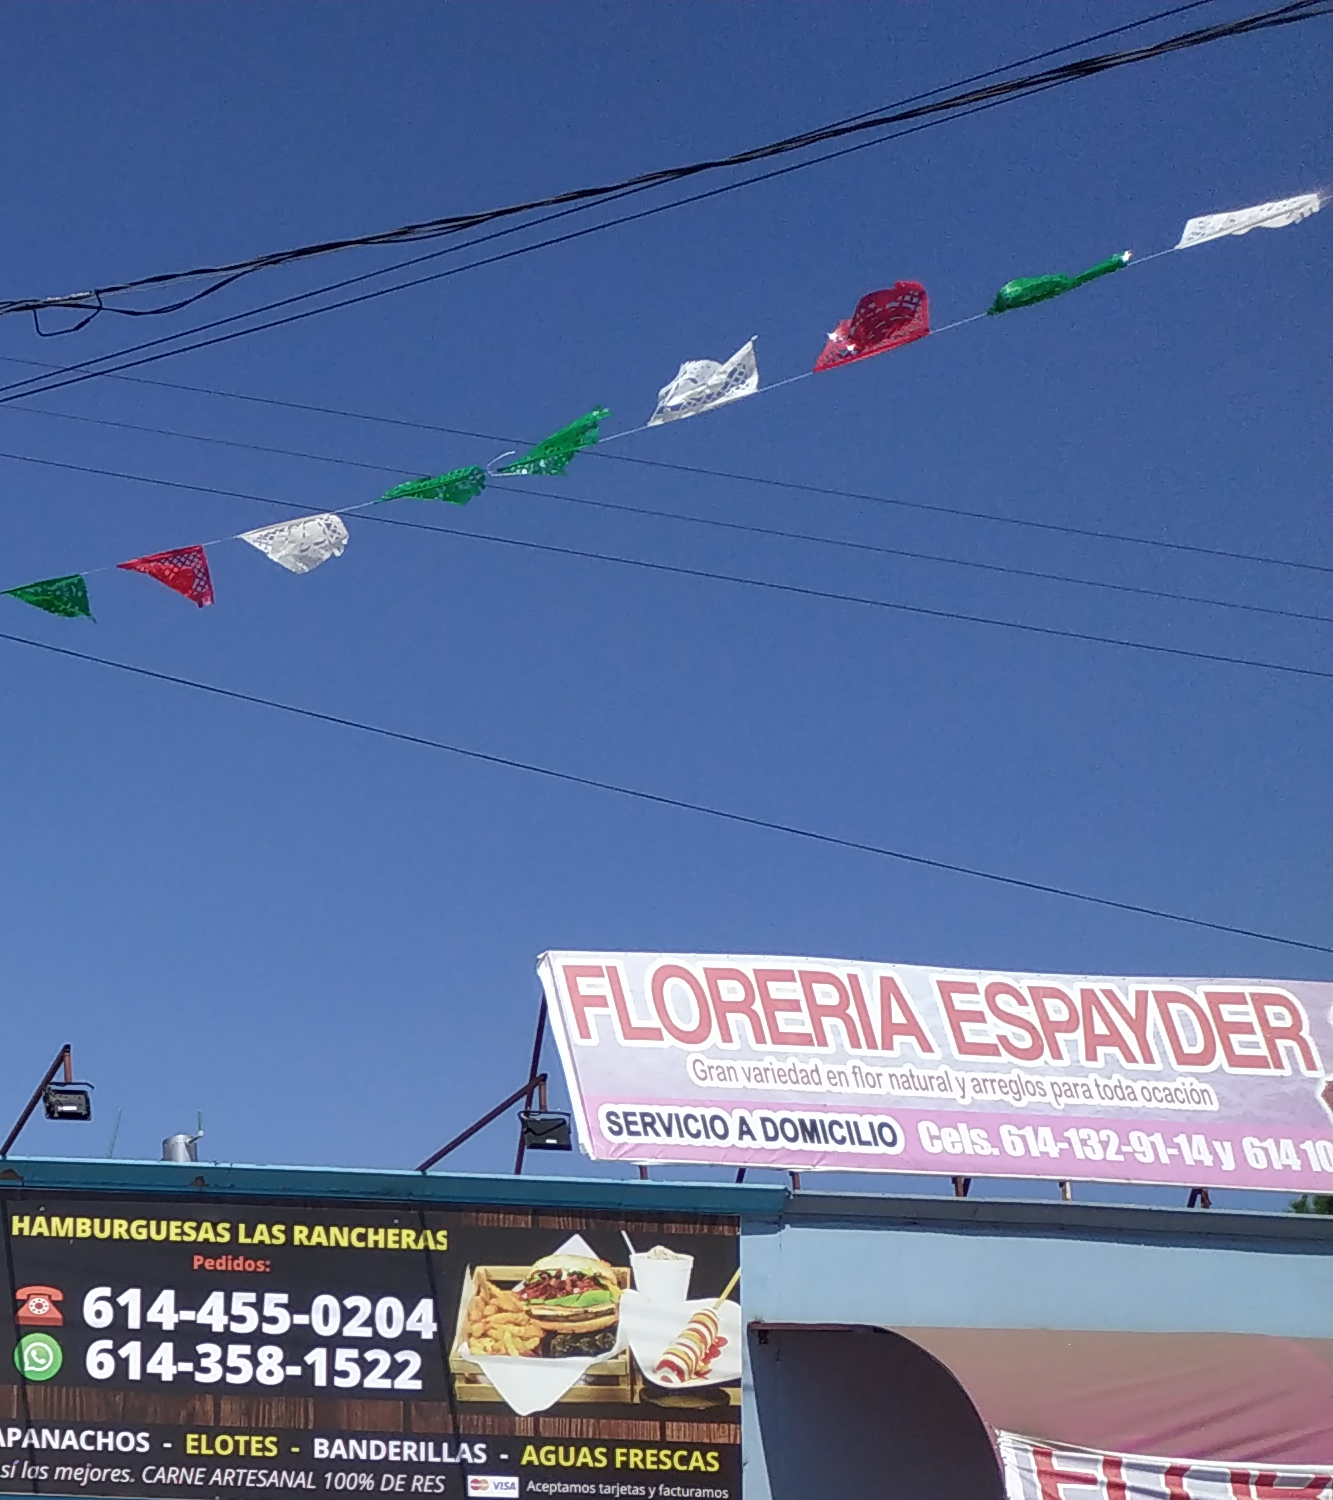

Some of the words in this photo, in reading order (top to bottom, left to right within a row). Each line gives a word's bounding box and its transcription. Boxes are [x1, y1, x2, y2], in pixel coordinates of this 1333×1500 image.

[562, 963, 935, 1054] FLORERIA
[936, 980, 1317, 1072] ESPAYDER
[693, 1059, 738, 1082] Gran
[742, 1060, 823, 1087] variedad
[827, 1070, 850, 1088] en
[852, 1066, 883, 1090] flor
[890, 1071, 950, 1094] natural
[954, 1077, 966, 1098] y
[972, 1074, 1047, 1101] arreglos
[1052, 1082, 1091, 1106] para
[1095, 1081, 1138, 1102] toda
[1141, 1083, 1214, 1106] ocación
[605, 1110, 729, 1140] SERVICIO
[738, 1116, 755, 1142] A
[762, 1116, 898, 1148] DOMICILIO
[917, 1120, 1000, 1155] Cels.
[1001, 1124, 1213, 1166] 614-132-91-14
[1213, 1139, 1236, 1171] y
[1242, 1137, 1301, 1171] 614
[11, 1215, 231, 1244] HAMBURGUESAS
[238, 1223, 286, 1246] LAS
[293, 1223, 449, 1251] RANCHERAS
[193, 1254, 271, 1273] Pedidos:
[82, 1286, 438, 1340] 614-455-0204
[85, 1339, 423, 1390] 614-358-1522
[186, 1433, 278, 1457] ELOTES
[313, 1438, 487, 1464] BANDERILLAS
[520, 1445, 608, 1469] AGUAS
[615, 1448, 720, 1472] FRESCAS
[0, 1460, 20, 1479] sí
[21, 1460, 49, 1480] las
[54, 1463, 135, 1487] mejores.
[142, 1465, 206, 1486] CARNE
[208, 1468, 317, 1490] ARTESANAL
[323, 1471, 375, 1491] 100%
[380, 1474, 408, 1492] DE
[410, 1475, 446, 1493] RES
[493, 1481, 517, 1491] VISA
[526, 1479, 596, 1497] Aceptamos
[598, 1482, 645, 1498] tarjetas
[648, 1486, 657, 1499] y
[658, 1483, 729, 1499] facturamos
